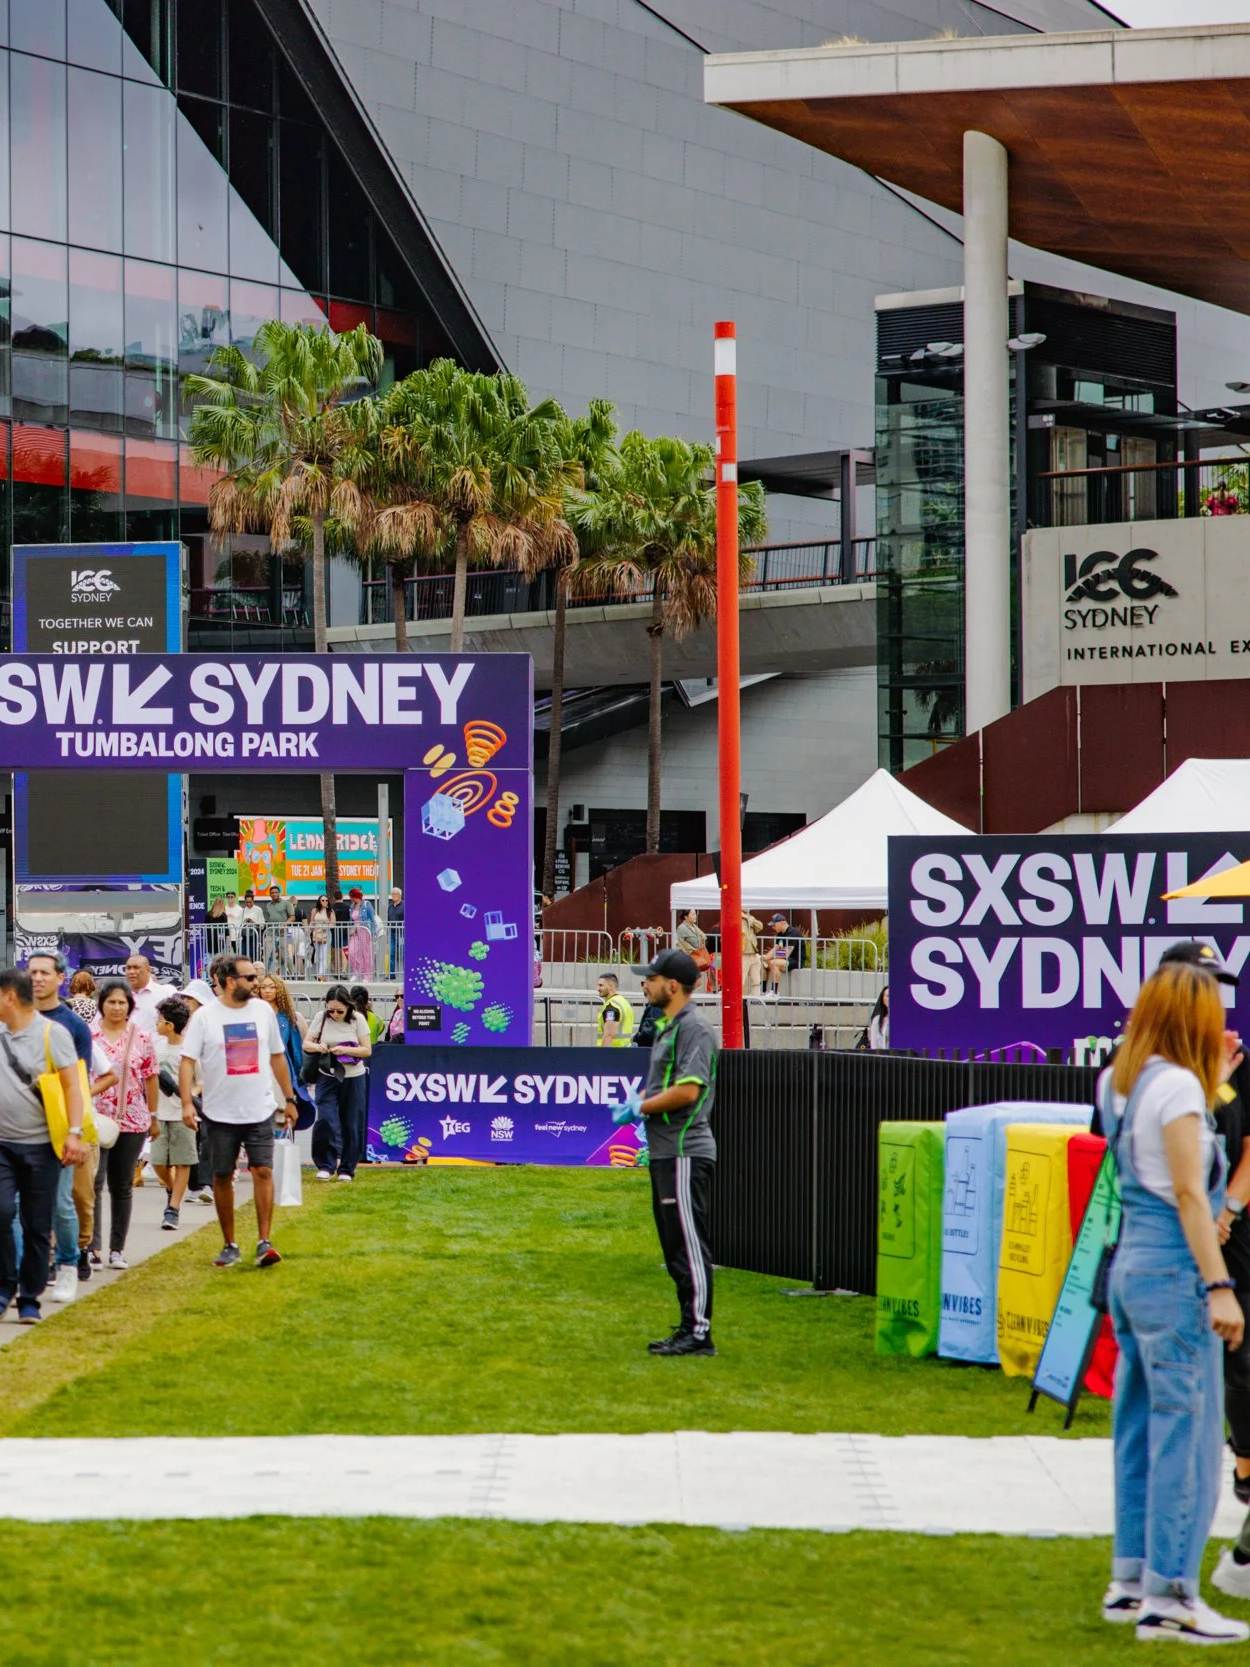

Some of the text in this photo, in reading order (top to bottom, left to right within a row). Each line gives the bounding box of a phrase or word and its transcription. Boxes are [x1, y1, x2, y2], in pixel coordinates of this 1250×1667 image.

[71, 593, 112, 603] SYDNEY
[39, 616, 153, 630] TOGETHER WE CAN
[1064, 605, 1160, 630] SYDNEY
[52, 640, 140, 654] SUPPORT
[1067, 640, 1250, 661] INTERNATIONAL EX
[190, 662, 475, 727] SYDNEY
[56, 731, 319, 758] TUMBALONG PARK
[291, 865, 302, 877] TUE
[303, 865, 310, 876] 21
[310, 865, 322, 877] JAN
[339, 864, 361, 877] SYDNEY
[514, 1075, 642, 1105] SYDNEY
[535, 1123, 548, 1131] feel
[563, 1124, 587, 1133] sydney
